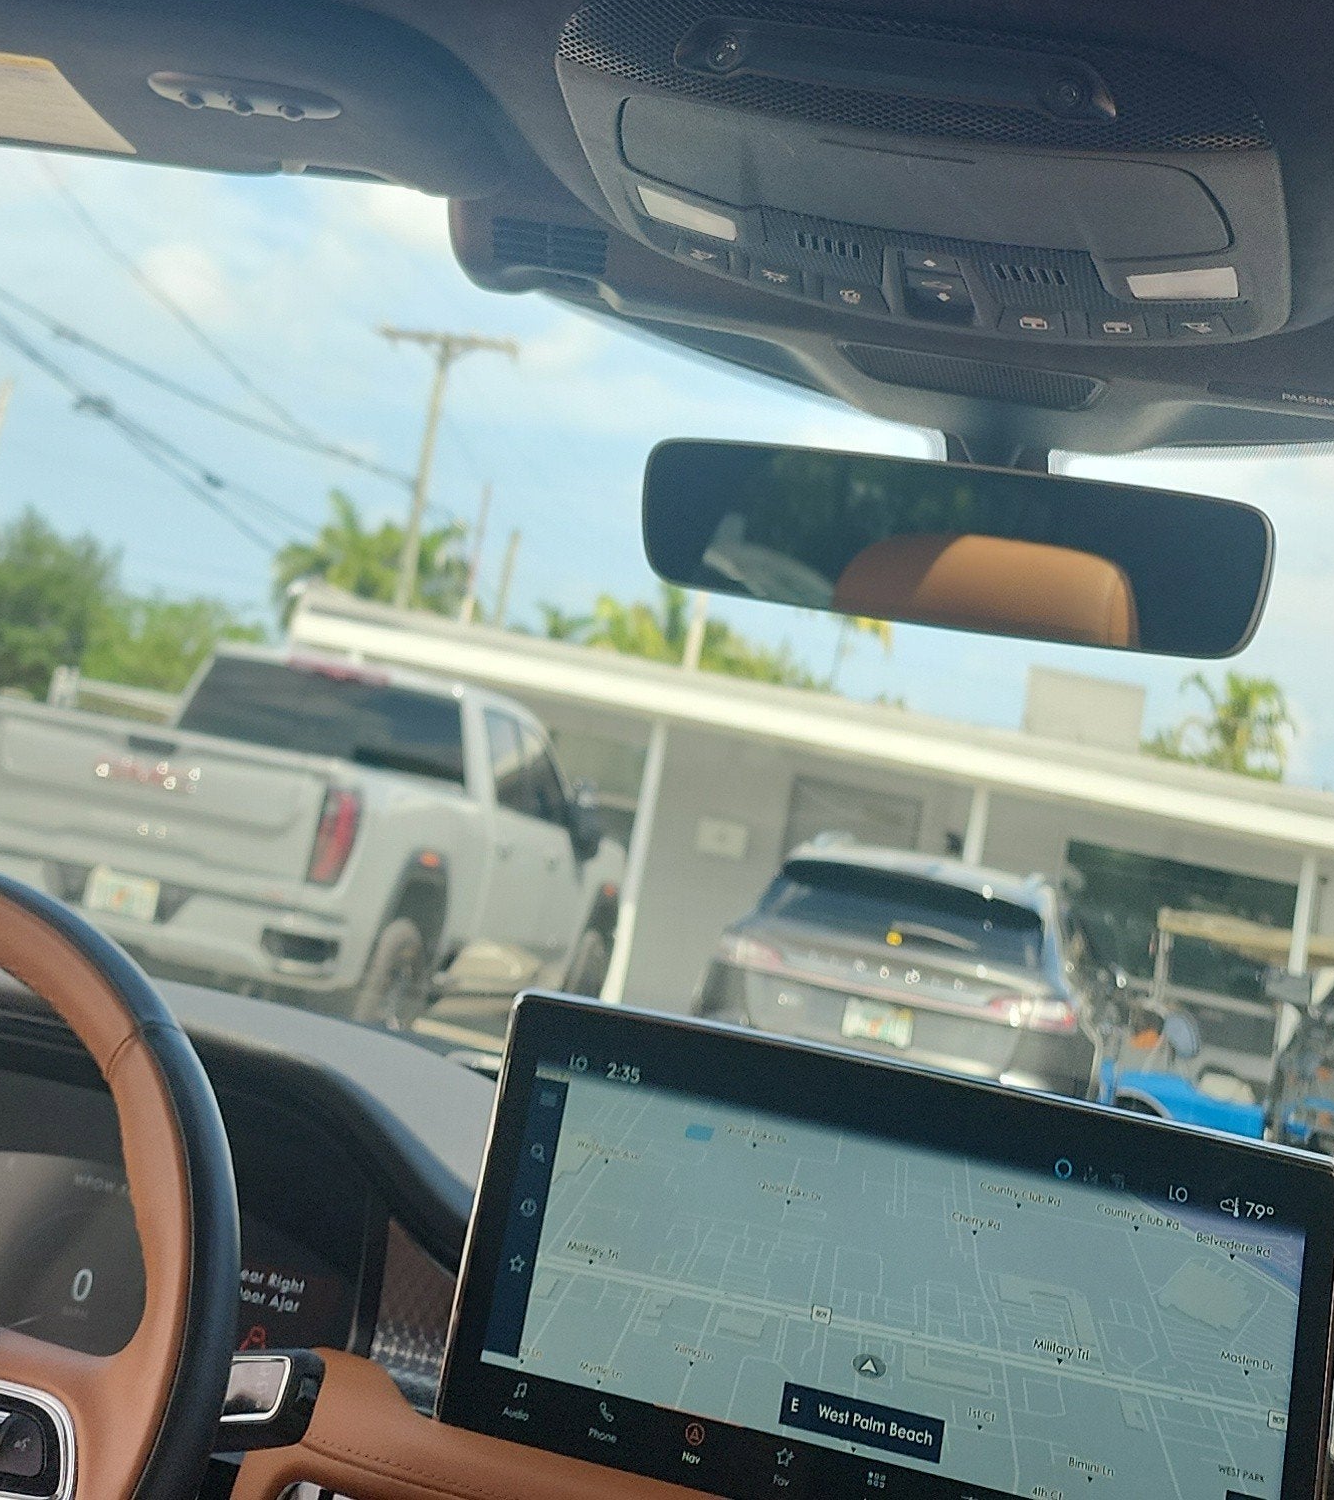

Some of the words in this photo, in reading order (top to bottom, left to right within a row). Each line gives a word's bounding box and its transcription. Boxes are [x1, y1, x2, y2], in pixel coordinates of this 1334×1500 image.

[569, 1053, 589, 1073] LO
[606, 1061, 642, 1085] 2:35
[979, 1181, 1020, 1200] Country
[1021, 1189, 1045, 1204] Club
[1047, 1196, 1062, 1208] Rd
[1168, 1185, 1188, 1203] LO
[1245, 1201, 1275, 1220] 79°
[952, 1211, 985, 1229] Cherry
[986, 1219, 1002, 1231] Rd
[1096, 1203, 1137, 1222] Country
[1139, 1212, 1164, 1228] Club
[1166, 1218, 1180, 1231] Rd
[1196, 1231, 1254, 1254] Belvedere
[1255, 1245, 1271, 1258] Rd
[72, 1267, 94, 1301] 0
[240, 1268, 265, 1284] ear
[267, 1271, 306, 1295] Right
[239, 1286, 267, 1305] oor
[267, 1293, 301, 1314] Ajar
[1033, 1337, 1075, 1360] Military
[1077, 1347, 1090, 1361] Trl
[1220, 1350, 1259, 1369] Masten
[1261, 1359, 1275, 1371] Dr
[501, 1405, 529, 1422] Audio
[790, 1397, 799, 1413] E
[818, 1402, 850, 1426] West
[852, 1412, 886, 1436] Palm
[889, 1421, 933, 1447] Beach
[588, 1427, 617, 1444] Phone
[681, 1450, 701, 1465] Nav
[1068, 1455, 1101, 1475] Bimini
[1102, 1464, 1114, 1477] Ln
[772, 1473, 791, 1488] Fav
[1218, 1463, 1240, 1480] WEST
[1241, 1469, 1266, 1483] PARK
[1031, 1485, 1048, 1498] 4th
